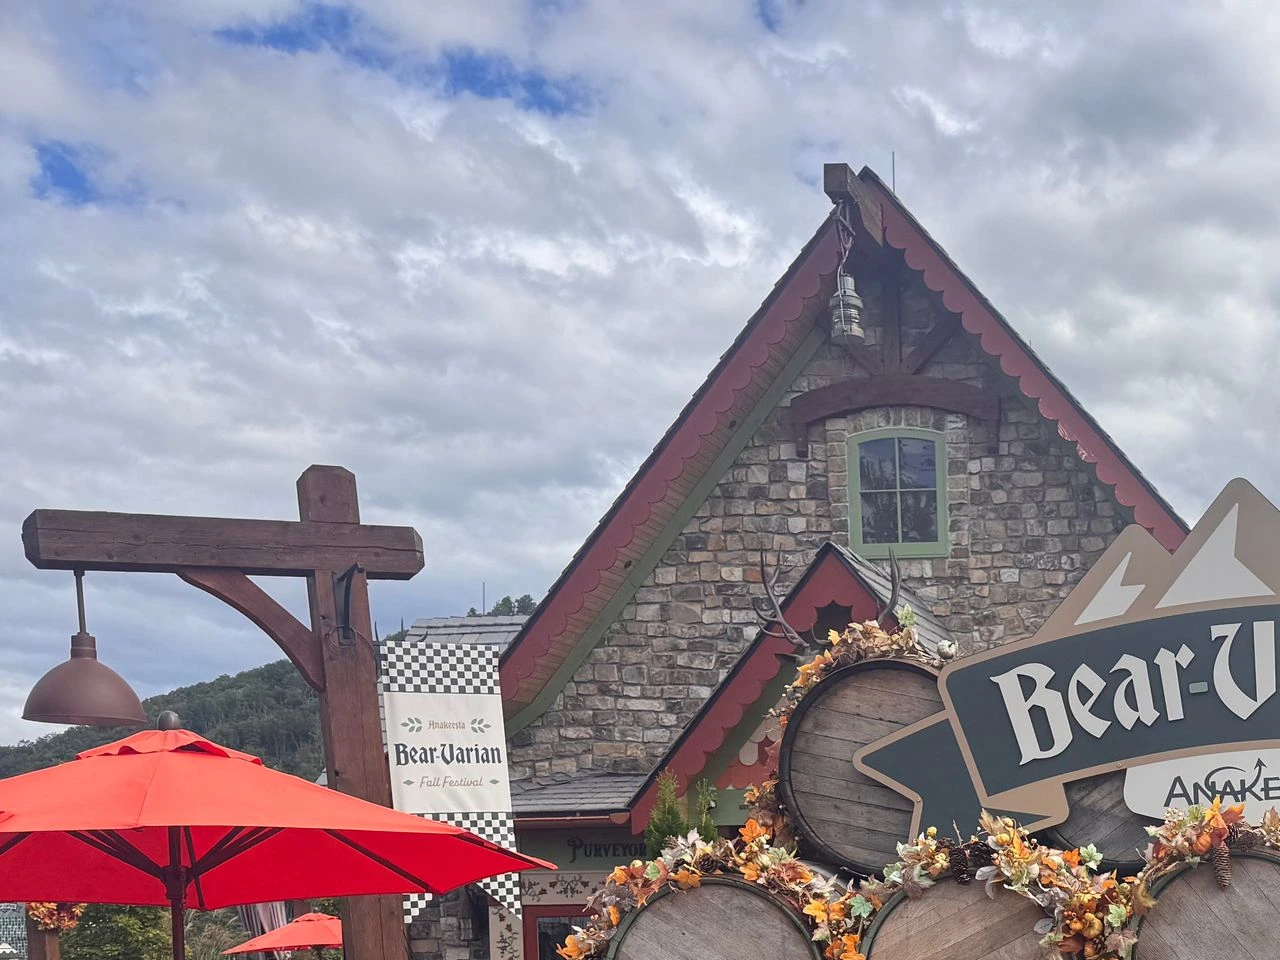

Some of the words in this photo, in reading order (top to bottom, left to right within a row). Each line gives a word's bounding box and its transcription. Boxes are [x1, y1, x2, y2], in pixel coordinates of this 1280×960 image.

[427, 719, 466, 730] Anakeesta
[393, 742, 503, 766] Bear-Varian
[419, 776, 441, 789] Fall
[442, 775, 484, 788] Festival
